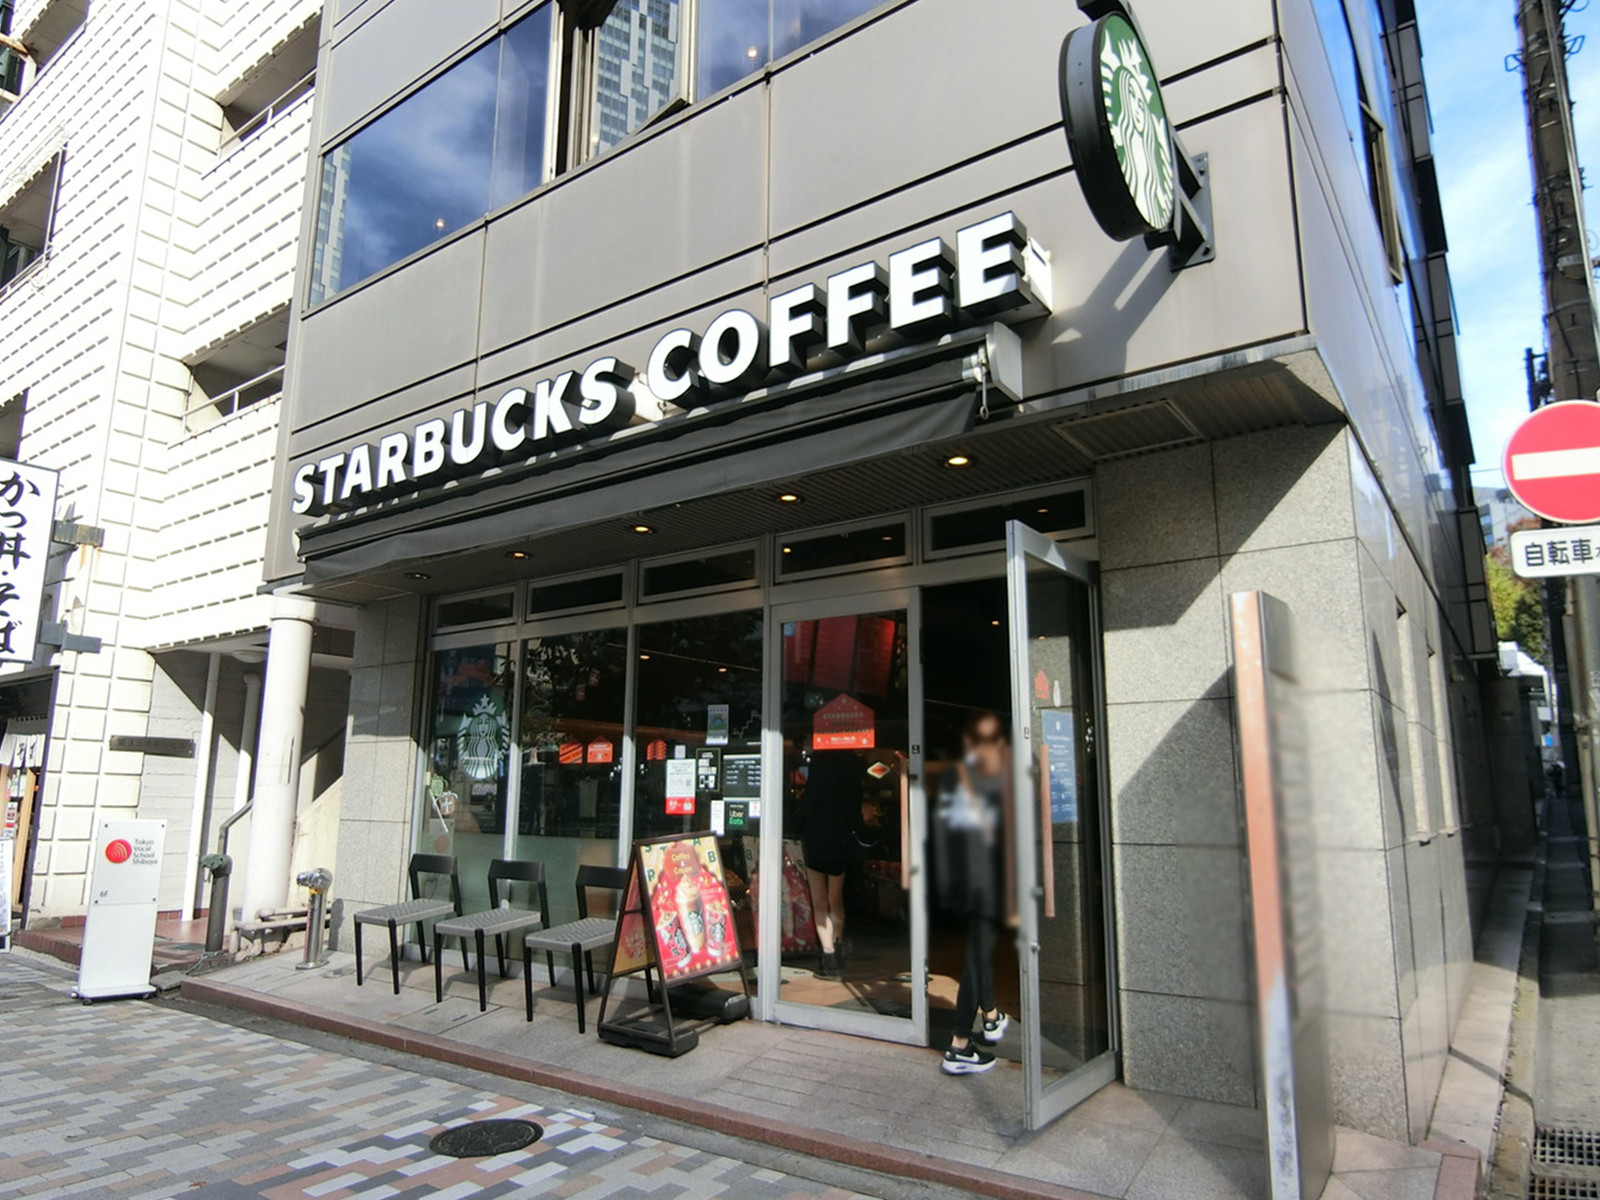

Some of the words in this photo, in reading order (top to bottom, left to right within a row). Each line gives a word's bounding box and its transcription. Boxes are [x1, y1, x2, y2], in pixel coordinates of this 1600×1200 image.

[291, 356, 620, 515] STARBUCKS
[646, 210, 1022, 401] COFFEE
[729, 809, 744, 818] Uber
[729, 817, 744, 825] Eats
[134, 838, 154, 846] Tokyo
